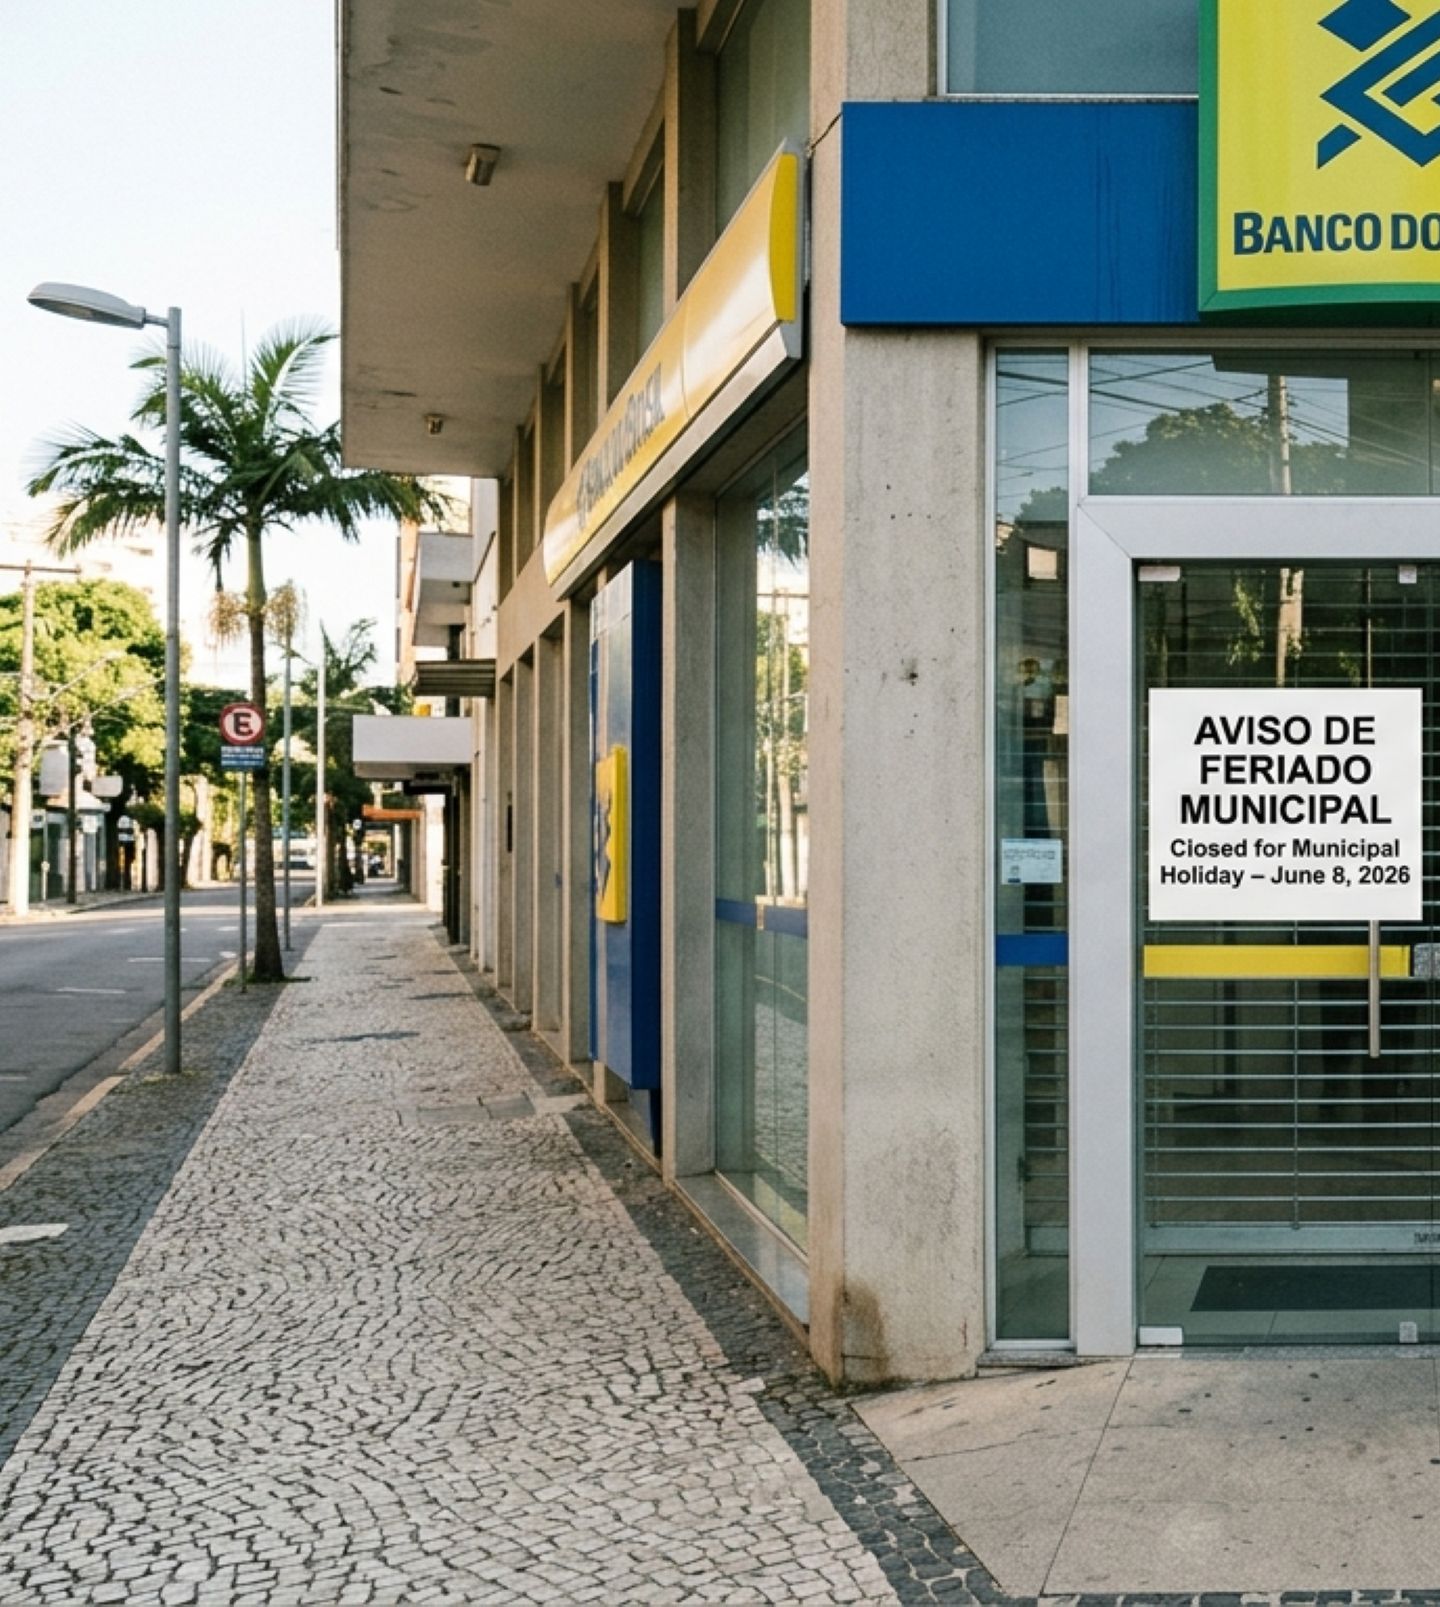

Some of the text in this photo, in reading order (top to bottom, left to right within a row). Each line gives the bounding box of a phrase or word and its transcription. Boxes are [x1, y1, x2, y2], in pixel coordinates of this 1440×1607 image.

[1233, 211, 1382, 255] BANCO
[233, 712, 254, 737] E
[1194, 715, 1376, 746] AVISO DE
[1200, 754, 1372, 785] FERIADO
[1180, 794, 1392, 825] MUNICIPAL
[1253, 838, 1286, 858] for
[1292, 838, 1400, 862] Municipal
[1160, 865, 1245, 889] Holiday
[1271, 865, 1326, 885] June
[1331, 865, 1352, 888] 8,
[1358, 865, 1411, 885] 2026
